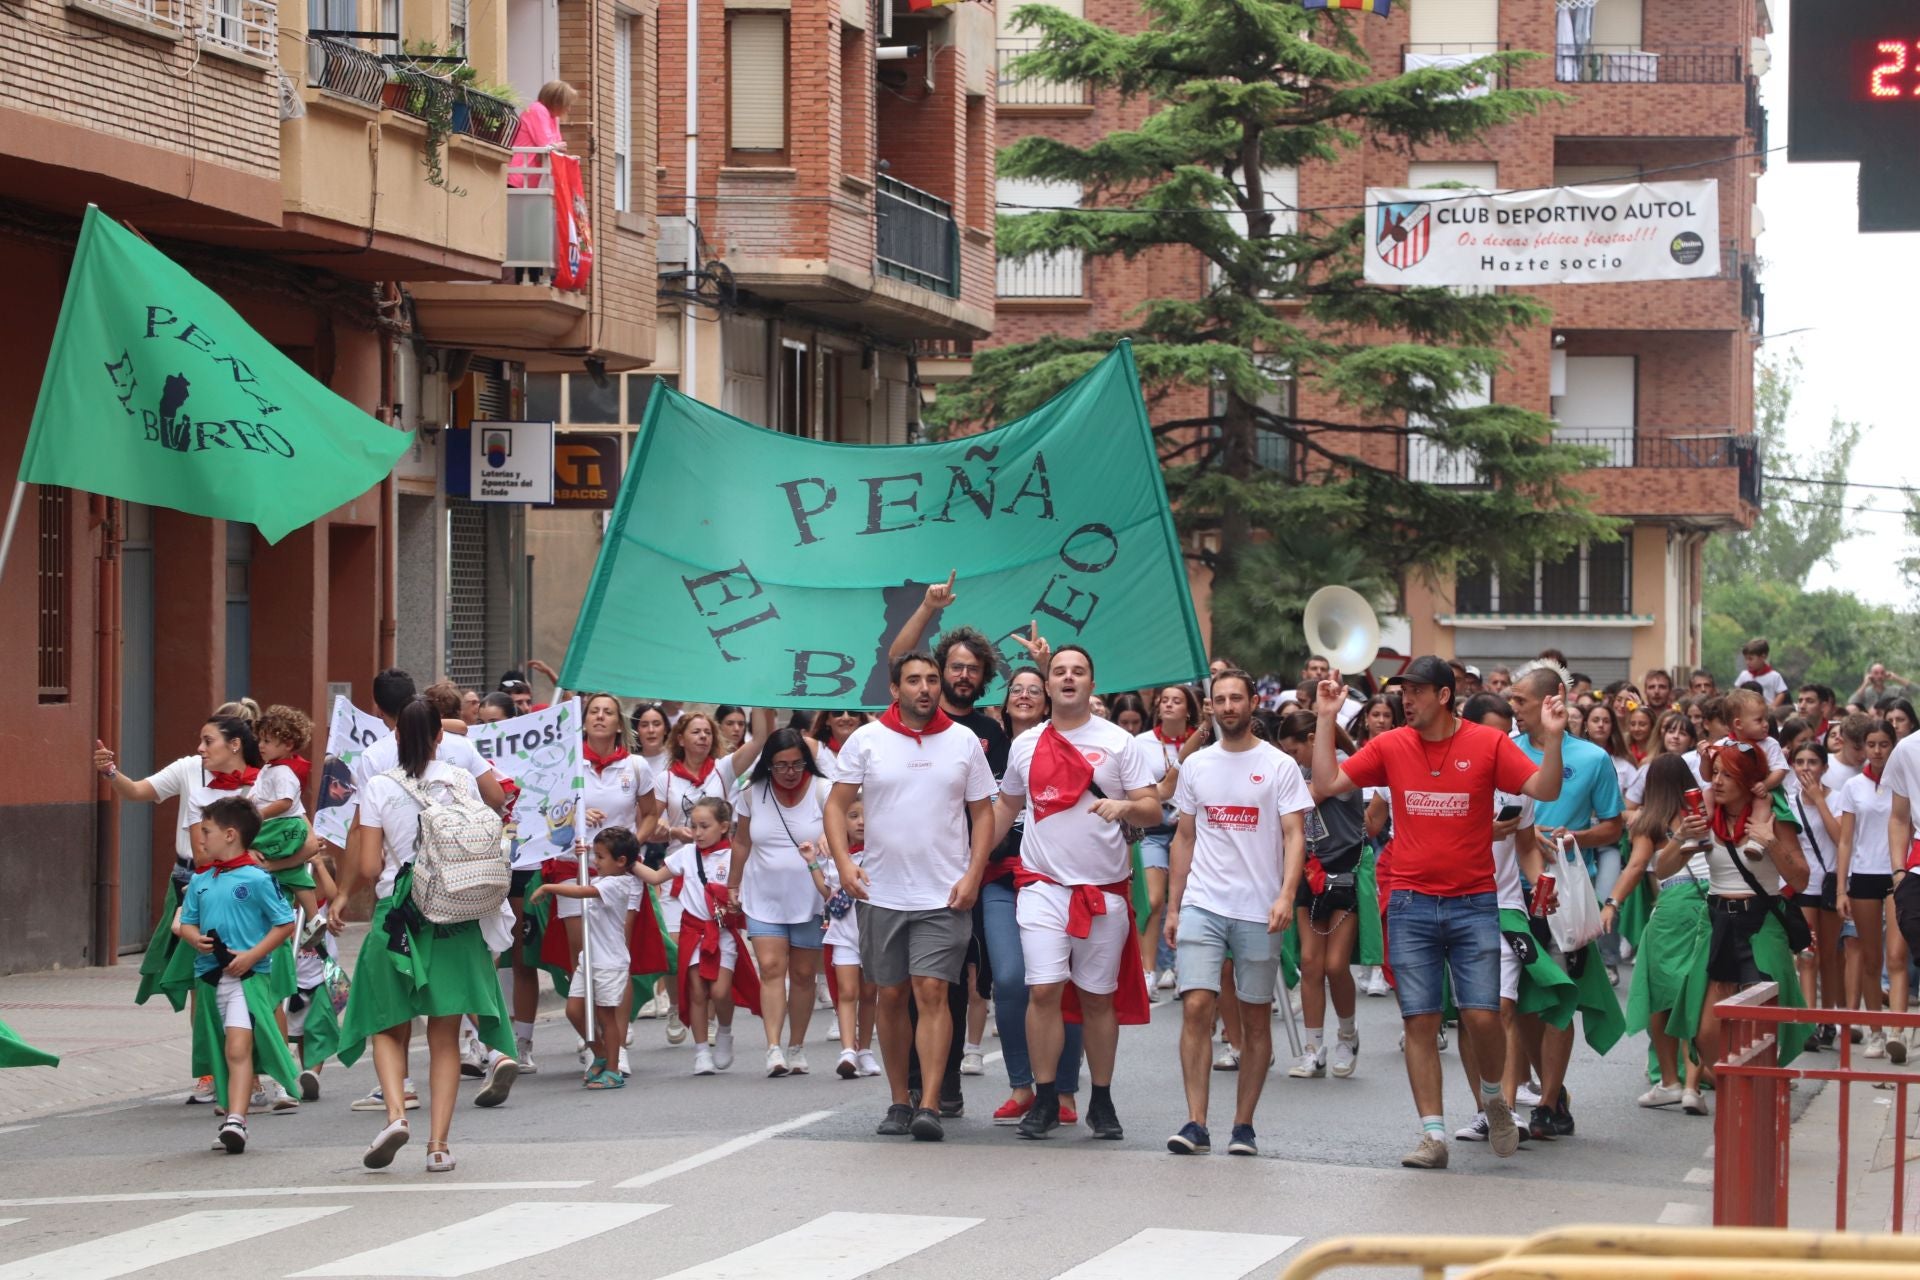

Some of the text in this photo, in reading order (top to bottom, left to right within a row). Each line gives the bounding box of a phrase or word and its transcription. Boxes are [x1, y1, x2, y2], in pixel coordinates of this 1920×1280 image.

[1871, 41, 1920, 96] 2
[1437, 201, 1696, 224] CLUB DEPORTIVO AUTOL
[1457, 231, 1477, 246] Os
[1533, 231, 1579, 248] felices
[1481, 254, 1622, 271] Hazte socio
[140, 408, 295, 458] BUREO
[481, 488, 509, 496] Estado
[482, 479, 518, 488] Apuestas
[554, 489, 608, 500] ABACOS
[776, 445, 1059, 547] PEÑA
[681, 559, 782, 663] EL
[476, 714, 562, 758] EITOS!
